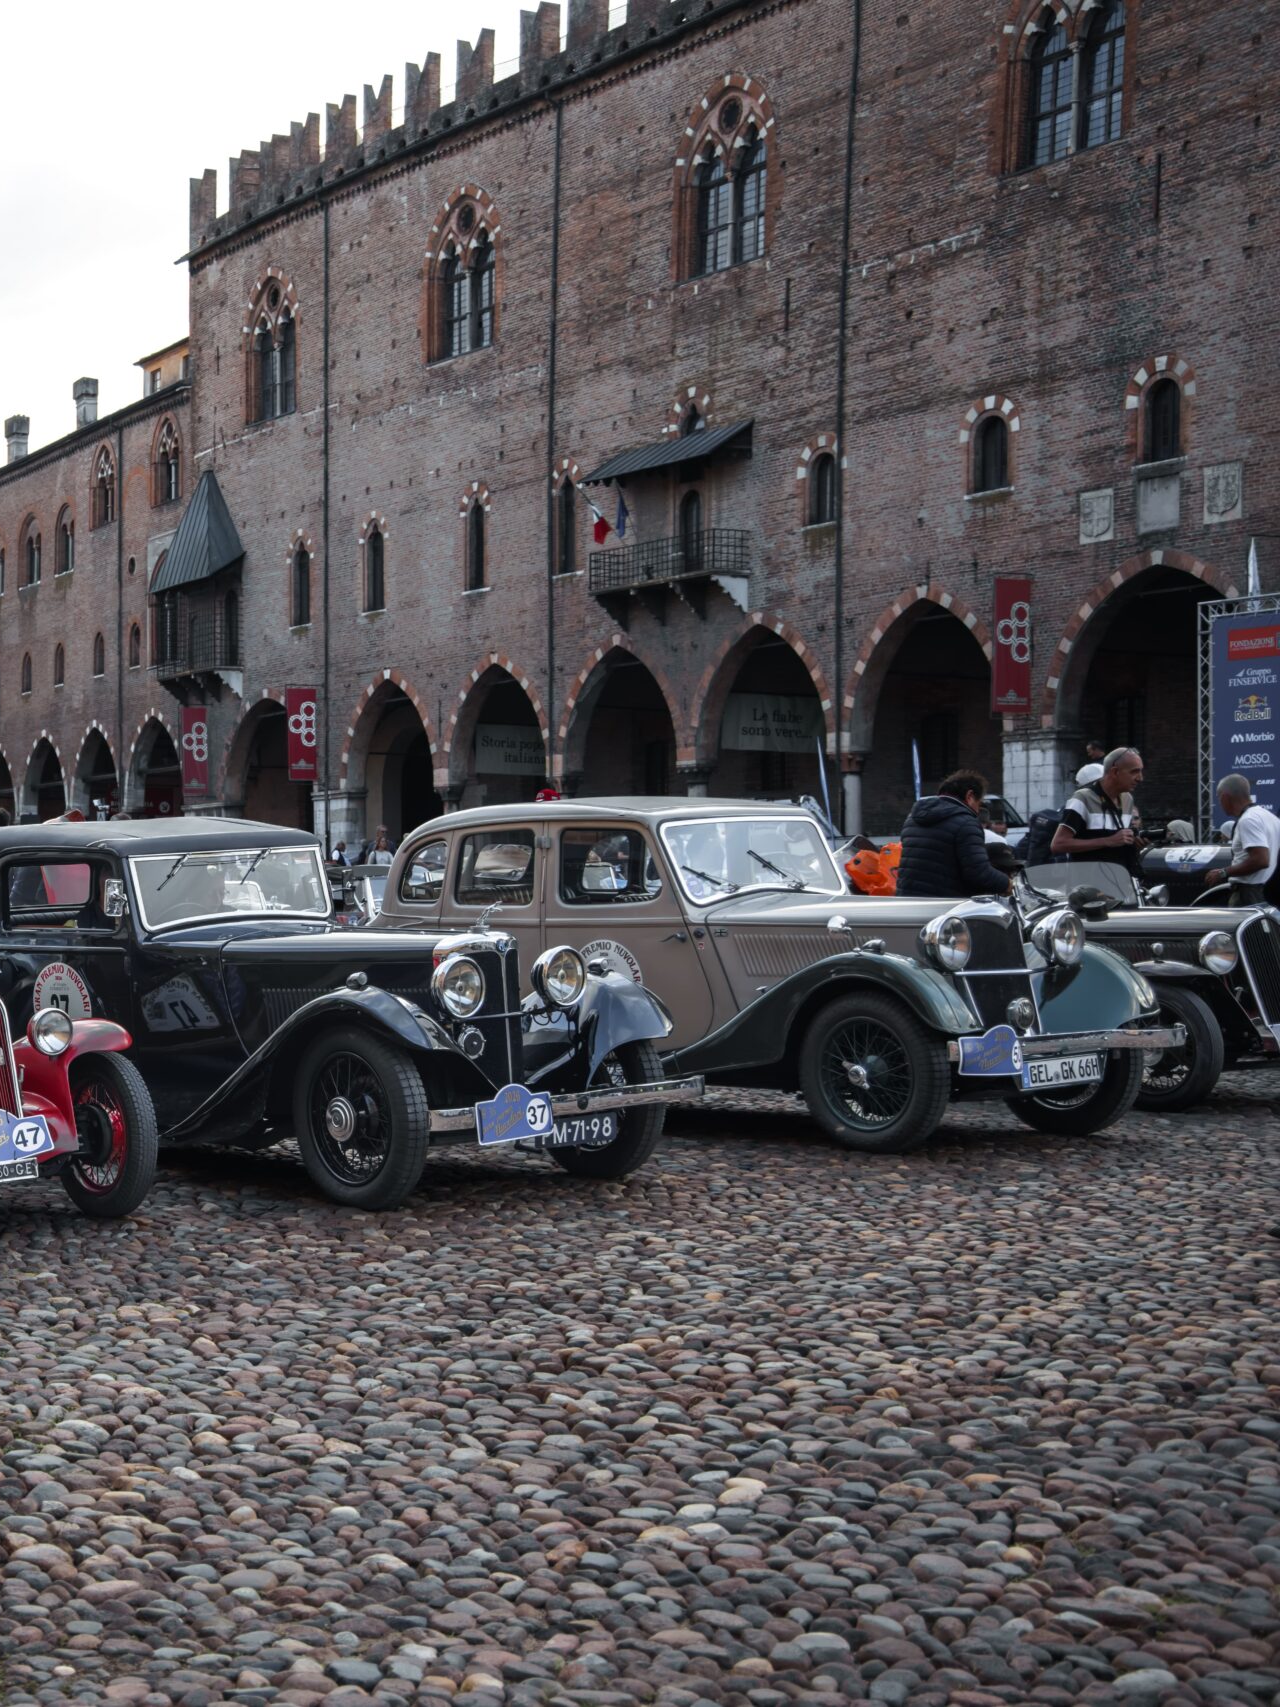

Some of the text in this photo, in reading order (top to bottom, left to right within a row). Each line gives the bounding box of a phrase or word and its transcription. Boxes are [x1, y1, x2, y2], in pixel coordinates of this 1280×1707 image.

[1246, 668, 1272, 677] Gruppo
[1228, 675, 1278, 687] FINSERVICE
[753, 708, 768, 721] Le
[741, 726, 771, 737] sono
[1245, 733, 1275, 742] Morbio
[481, 735, 545, 752] Storia popo
[1235, 753, 1269, 765] MOSSO
[1179, 848, 1202, 862] 32
[581, 941, 641, 983] PREMIO NUVOLAR
[41, 964, 64, 983] PREMIO
[66, 968, 90, 1012] NUVOLARI
[1029, 1057, 1100, 1085] GEL GK 66H
[527, 1104, 547, 1125] 37
[15, 1126, 40, 1147] 47
